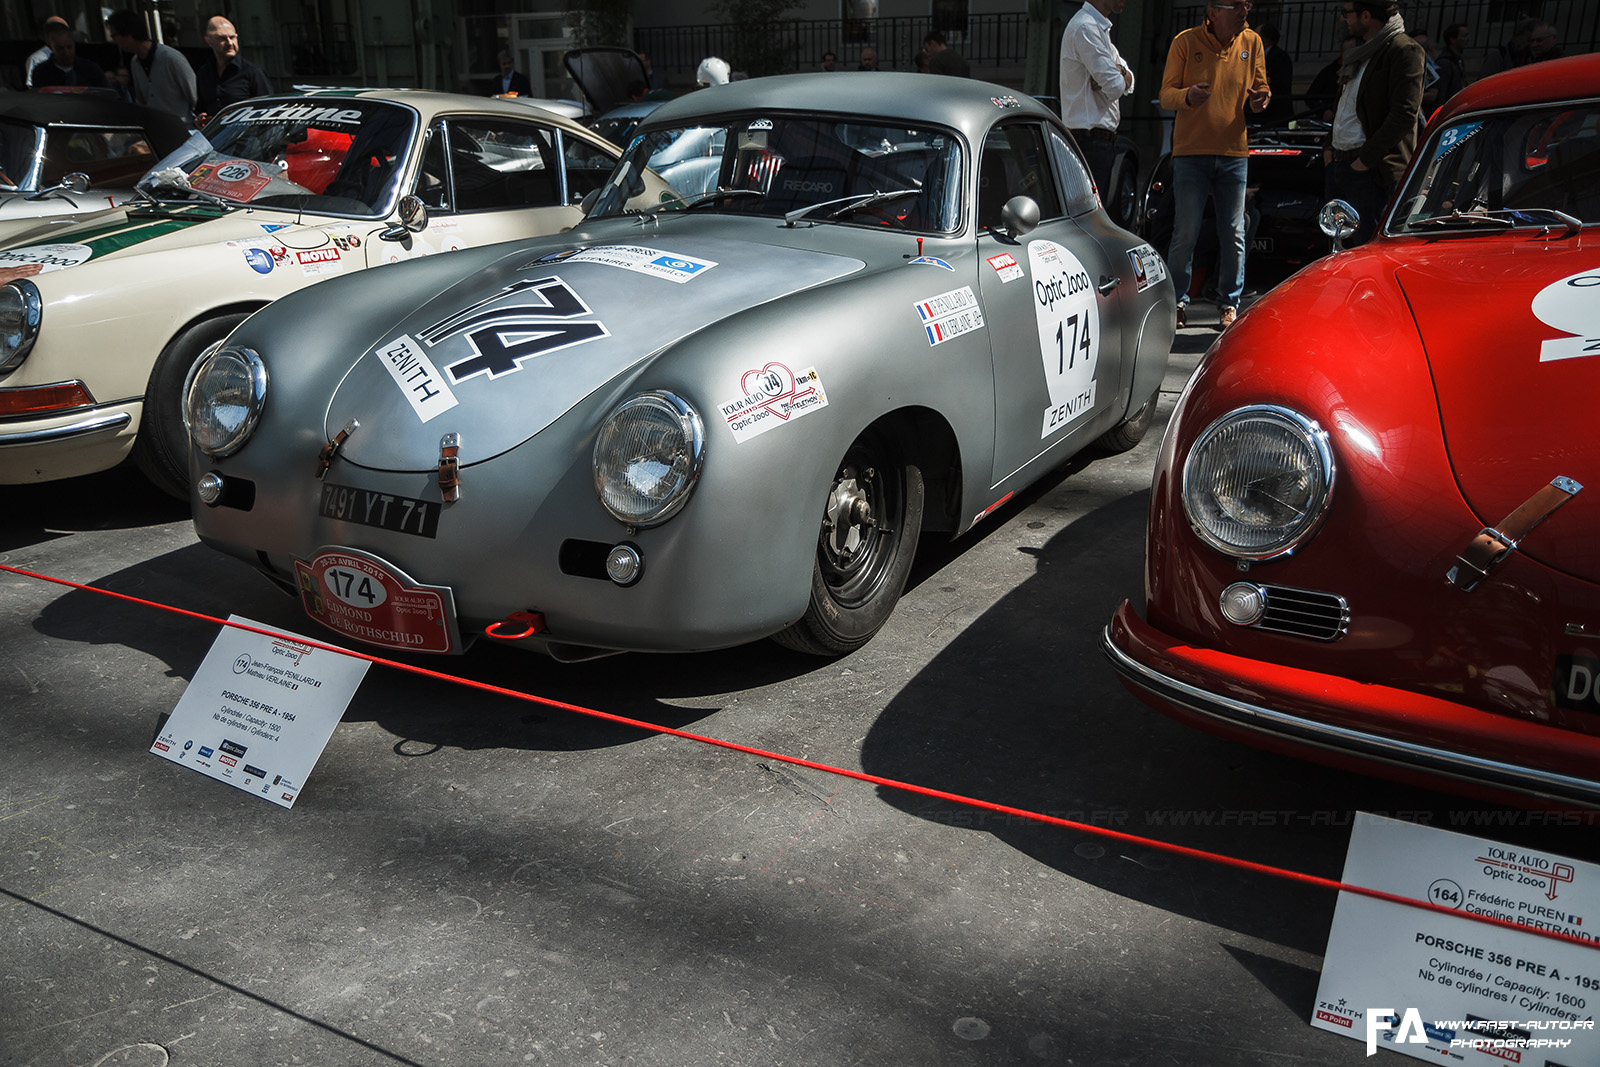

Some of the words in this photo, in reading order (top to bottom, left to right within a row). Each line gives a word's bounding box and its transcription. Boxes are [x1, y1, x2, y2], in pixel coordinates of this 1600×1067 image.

[1441, 129, 1458, 146] 3
[219, 166, 249, 180] 226
[783, 179, 834, 194] RECARO
[300, 249, 339, 263] MOTUL
[643, 264, 689, 278] essilor
[1036, 275, 1066, 312] Optic
[1062, 271, 1089, 295] 2000
[416, 275, 612, 385] 174
[1056, 309, 1091, 375] 174
[387, 343, 440, 402] ZENITH
[1050, 388, 1091, 428] ZENITH
[731, 416, 752, 432] Optic
[753, 410, 770, 423] 2000
[324, 487, 356, 519] 7491
[365, 492, 394, 526] YT
[400, 500, 428, 533] 71
[320, 557, 337, 568] 20-25
[338, 558, 362, 570] AVRIL
[363, 565, 385, 580] 2015
[329, 569, 376, 604] 174
[327, 599, 373, 622] EDMOND
[330, 615, 342, 628] DE
[344, 620, 424, 645] ROTHSCHILD
[236, 659, 248, 669] 174
[266, 674, 293, 689] VERLAINE
[221, 690, 250, 706] PORSCHE
[249, 700, 261, 710] 356
[260, 703, 274, 714] PRE
[273, 708, 278, 716] A
[282, 711, 297, 722] 1954
[268, 722, 282, 733] 1500
[1488, 847, 1517, 863] TOUR
[1518, 855, 1549, 870] AUTO
[1483, 865, 1514, 881] Optic
[1517, 873, 1546, 888] 2000
[1433, 887, 1458, 903] 164
[1467, 889, 1515, 909] Frédéric
[1518, 901, 1565, 922] PUREN
[1465, 903, 1513, 922] Caroline
[1516, 915, 1591, 941] BERTRAND
[1415, 933, 1484, 959] PORSCHE
[1487, 952, 1512, 967] 356
[1515, 959, 1547, 976] PRE
[1549, 969, 1561, 981] A
[1574, 975, 1600, 991] 195
[1429, 957, 1483, 982] Cylindrée
[1486, 973, 1492, 982] /
[1494, 975, 1551, 1000] Capacity:
[1555, 992, 1586, 1009] 1600
[1418, 969, 1435, 982] Nb
[1438, 974, 1453, 986] de
[1455, 979, 1508, 1003] cylindres
[1510, 995, 1517, 1004] /
[1519, 997, 1581, 1022] Cylinders:
[1319, 1001, 1362, 1019] ZENITH
[1319, 1012, 1327, 1020] Le
[1328, 1014, 1350, 1027] Point
[1479, 1045, 1519, 1061] MOTUL
